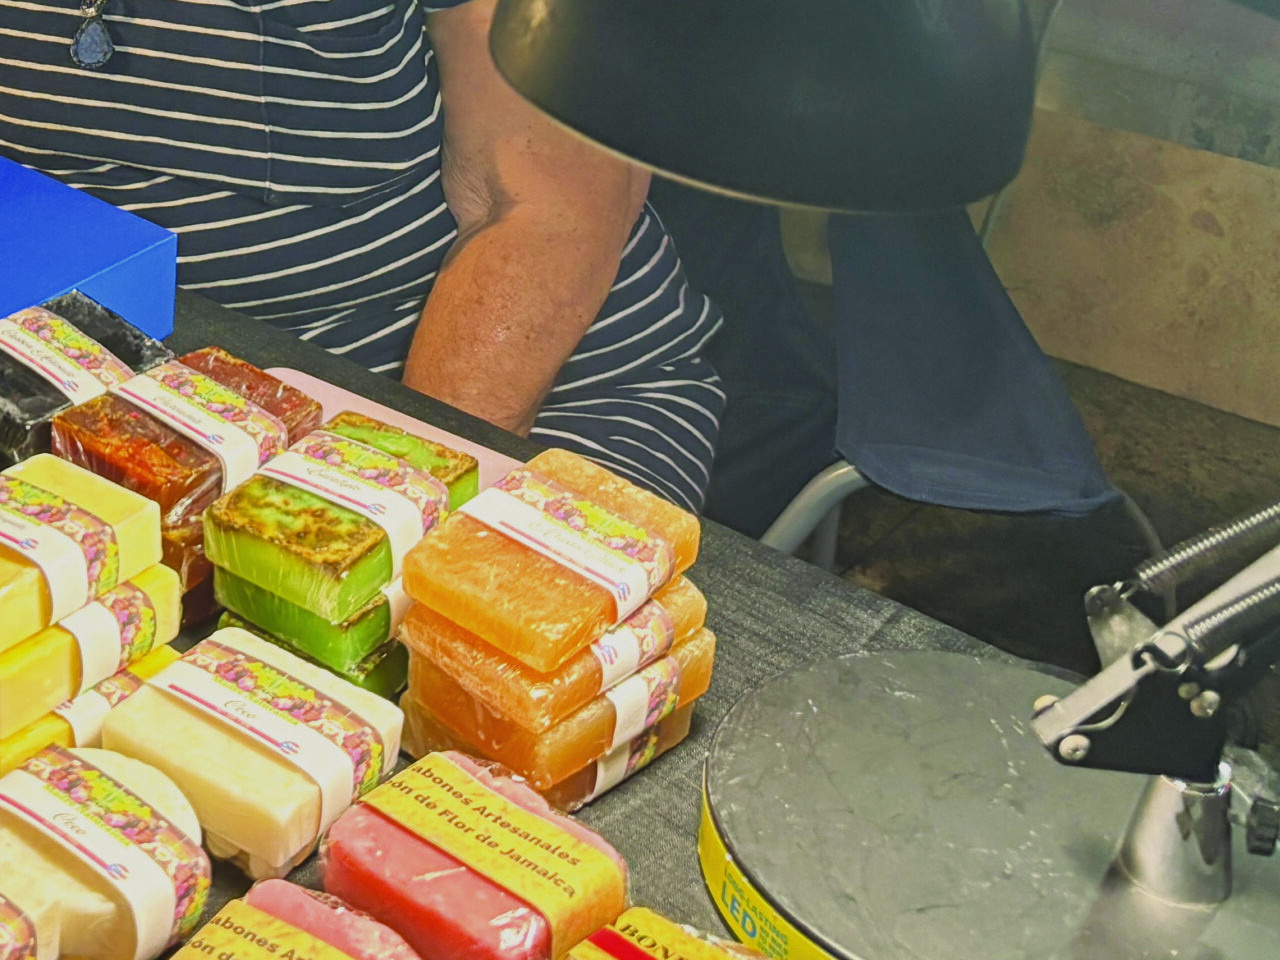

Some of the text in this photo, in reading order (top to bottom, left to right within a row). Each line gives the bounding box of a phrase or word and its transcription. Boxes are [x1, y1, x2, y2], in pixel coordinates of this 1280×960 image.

[411, 765, 582, 868] abones Artesanales
[414, 791, 438, 811] de
[438, 808, 476, 834] Flor
[475, 830, 500, 850] de
[500, 846, 576, 899] Jamaica
[209, 916, 280, 954] abones
[722, 881, 758, 939] LED
